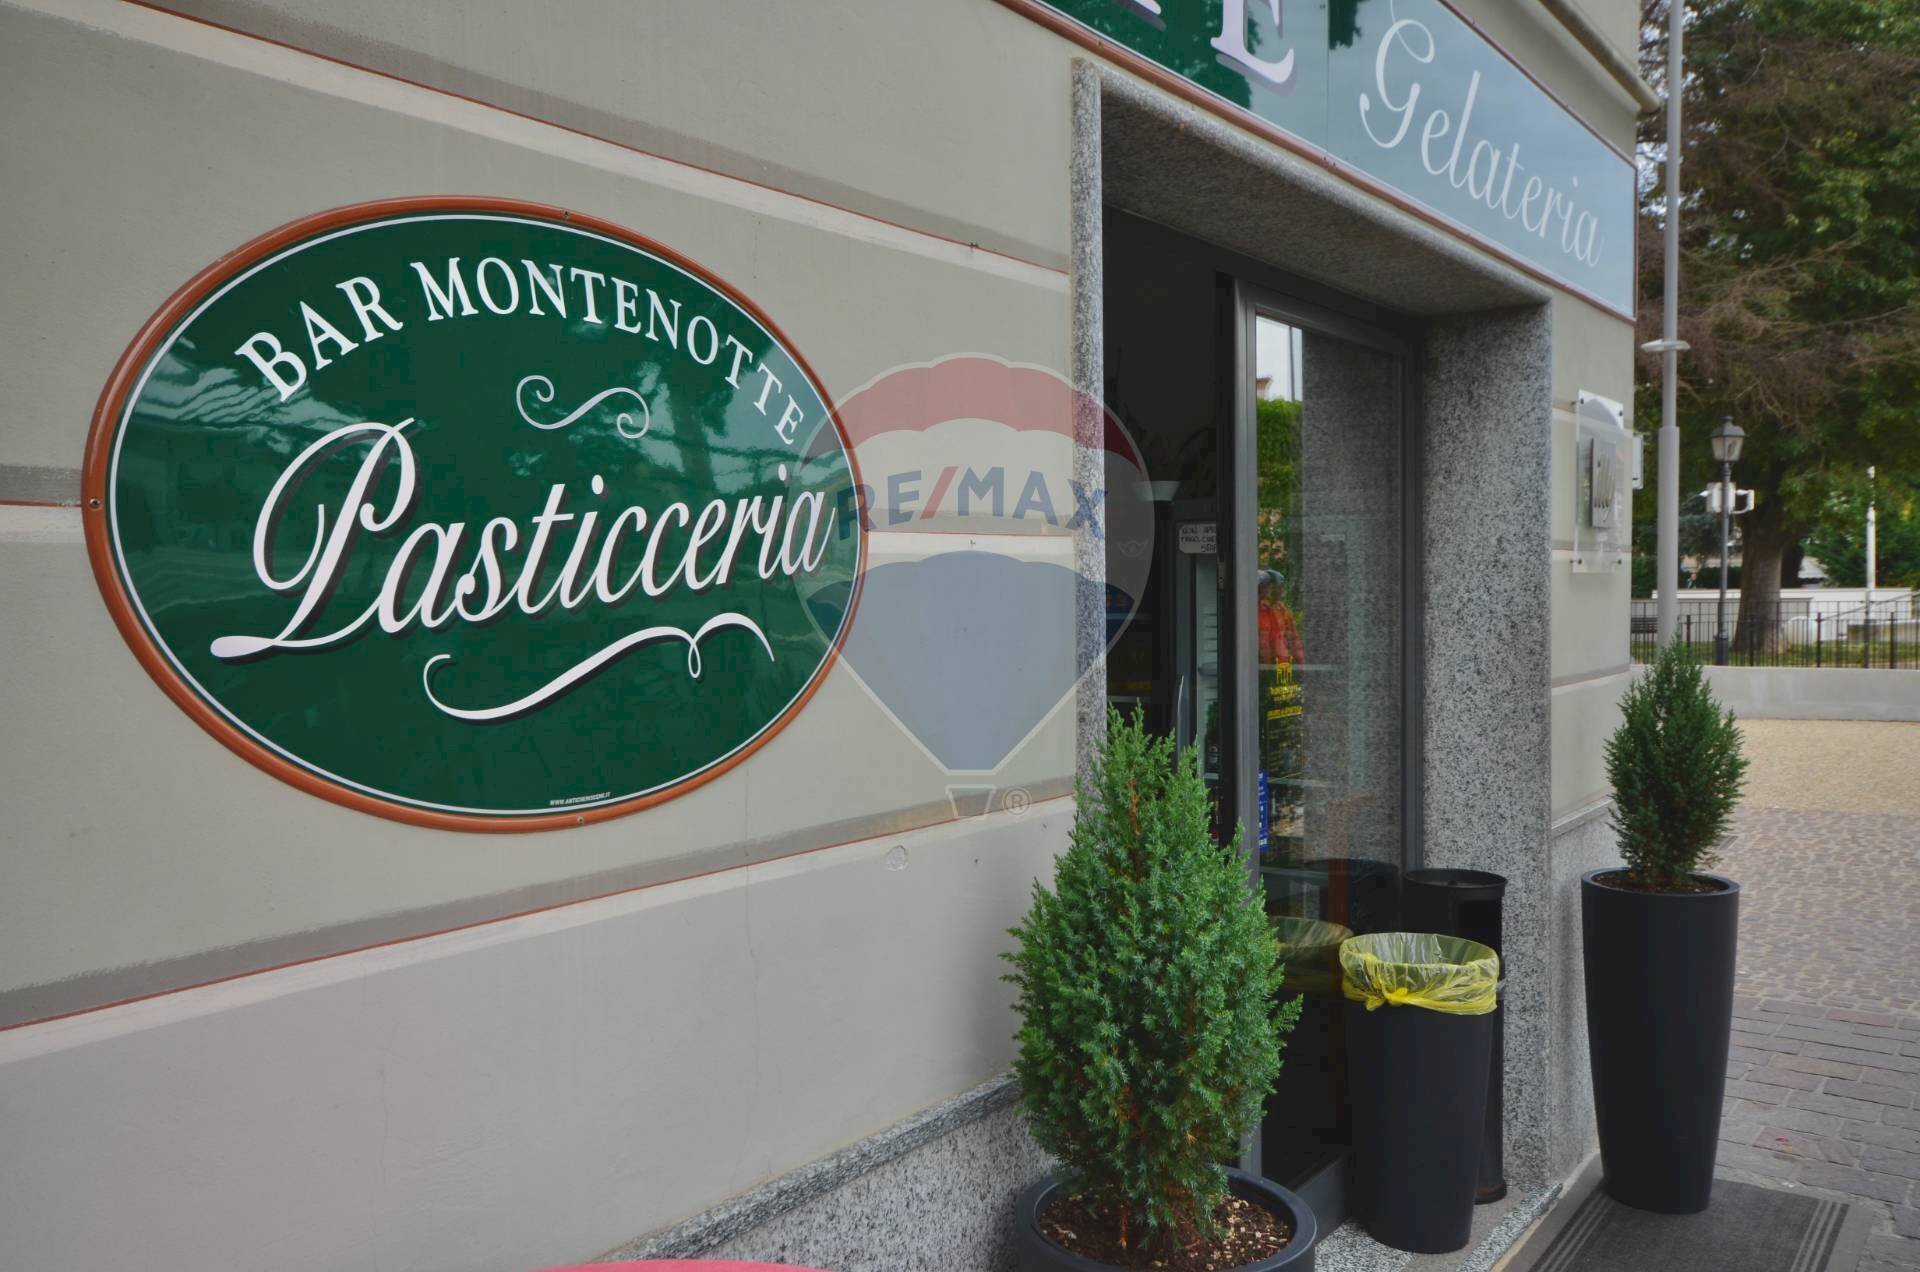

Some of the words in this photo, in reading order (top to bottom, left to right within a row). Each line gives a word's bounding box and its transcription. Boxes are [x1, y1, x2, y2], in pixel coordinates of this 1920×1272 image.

[1359, 0, 1600, 267] Gelateria
[235, 276, 404, 402] BAR
[410, 256, 806, 446] MONTENOTTE
[210, 416, 838, 660] Pasticceria
